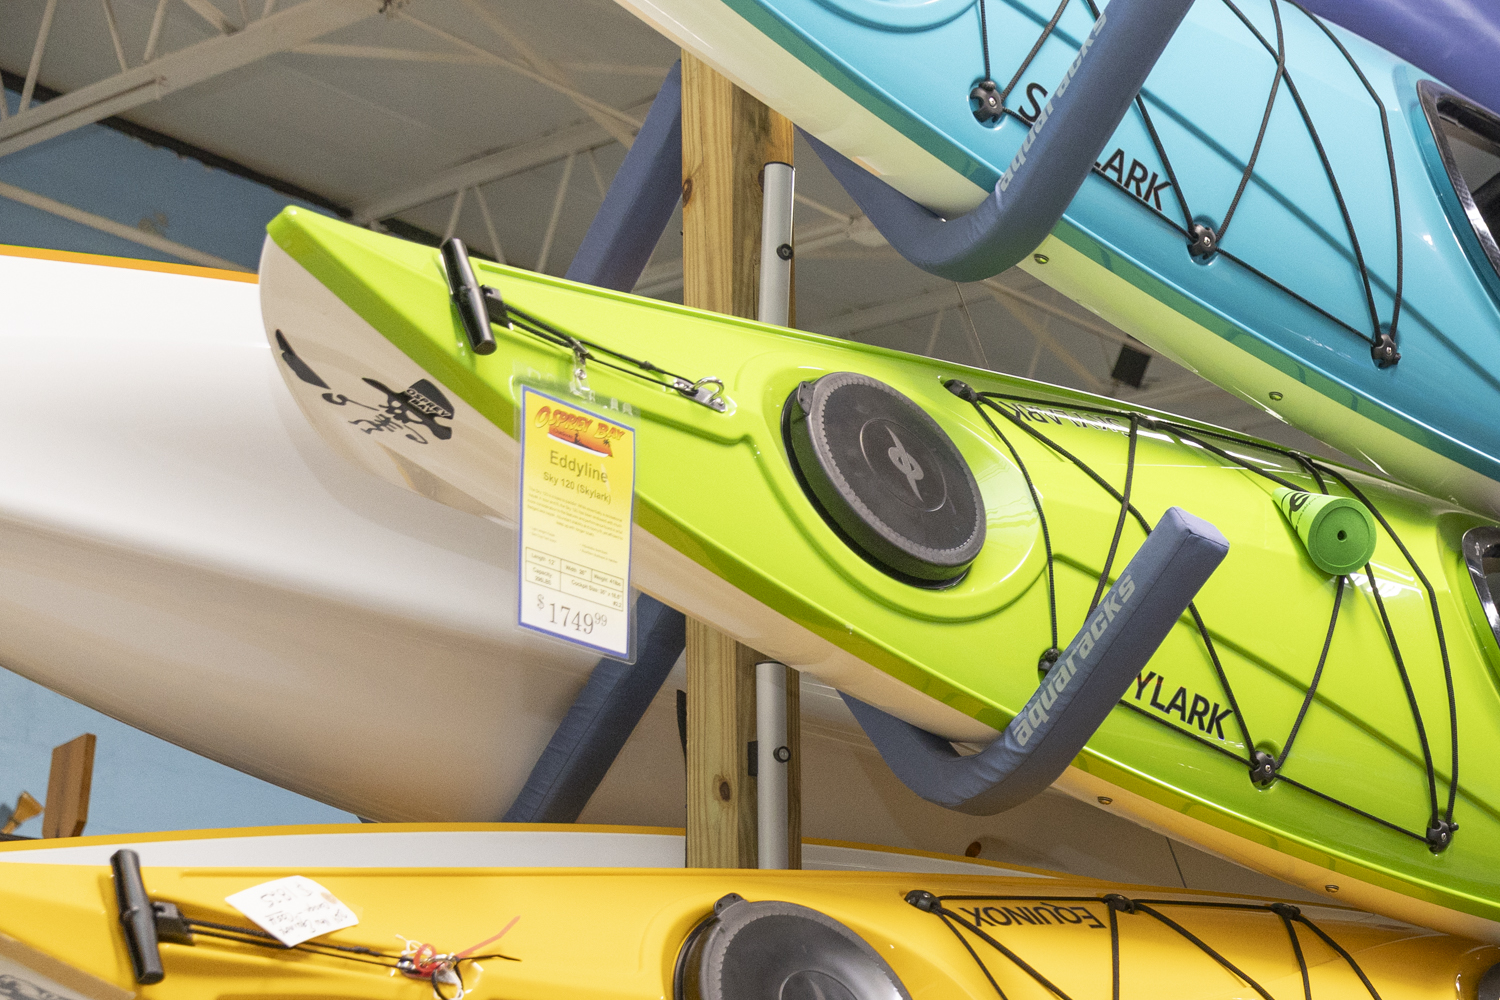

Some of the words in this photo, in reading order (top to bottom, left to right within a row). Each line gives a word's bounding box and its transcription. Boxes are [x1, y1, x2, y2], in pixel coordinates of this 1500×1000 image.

[1018, 82, 1172, 211] SARK
[534, 405, 594, 433] OSPREY
[594, 422, 626, 441] BAY
[550, 450, 608, 483] Eddyline
[543, 471, 558, 486] Sky
[561, 478, 575, 491] 120
[577, 484, 612, 505] (Skylark)
[1013, 575, 1136, 747] aquaracks
[1135, 671, 1233, 740] YLARK
[958, 902, 1107, 929] EQUINOX
